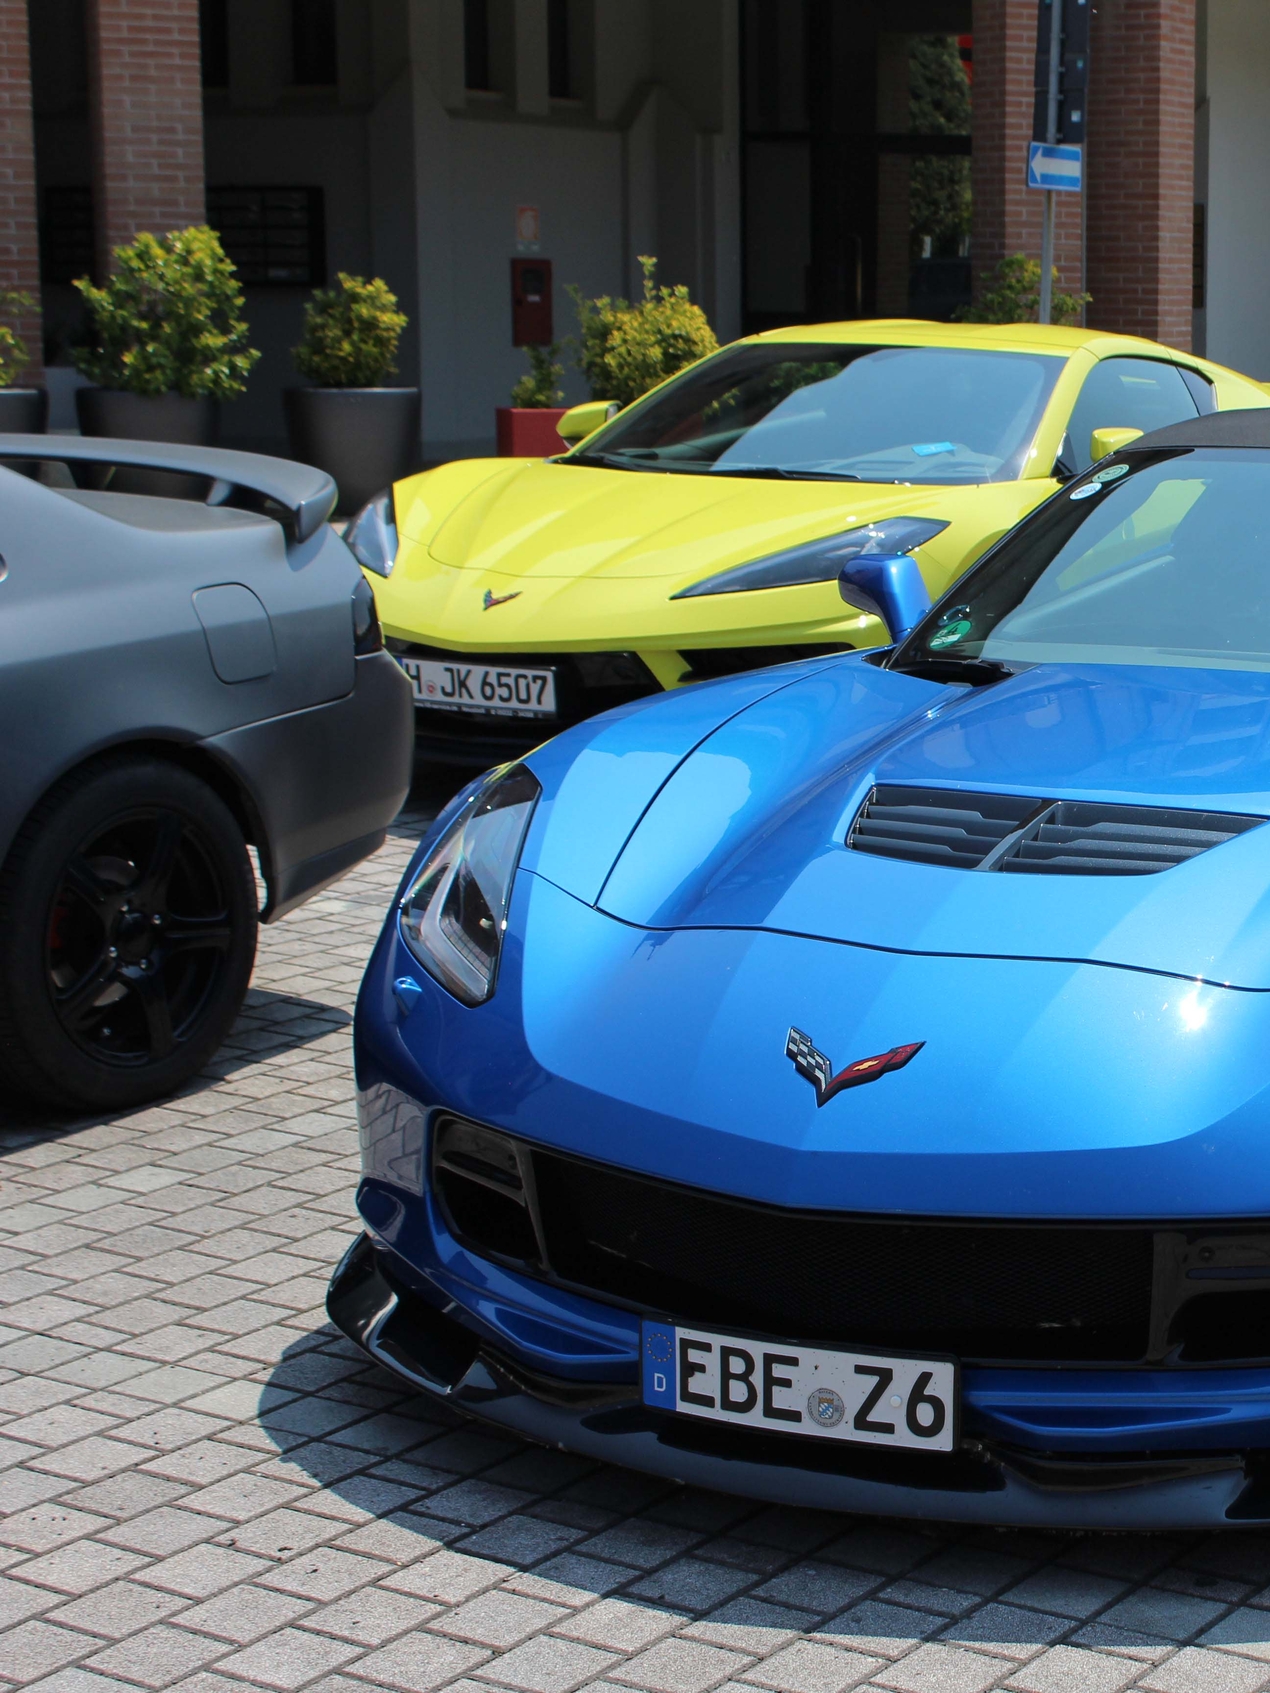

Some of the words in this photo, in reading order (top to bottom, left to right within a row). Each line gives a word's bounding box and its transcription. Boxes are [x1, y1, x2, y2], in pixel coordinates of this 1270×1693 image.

[404, 663, 423, 695] H
[440, 667, 475, 700] JK
[480, 670, 548, 706] 6507
[654, 1372, 667, 1392] D
[679, 1337, 803, 1423] EBE
